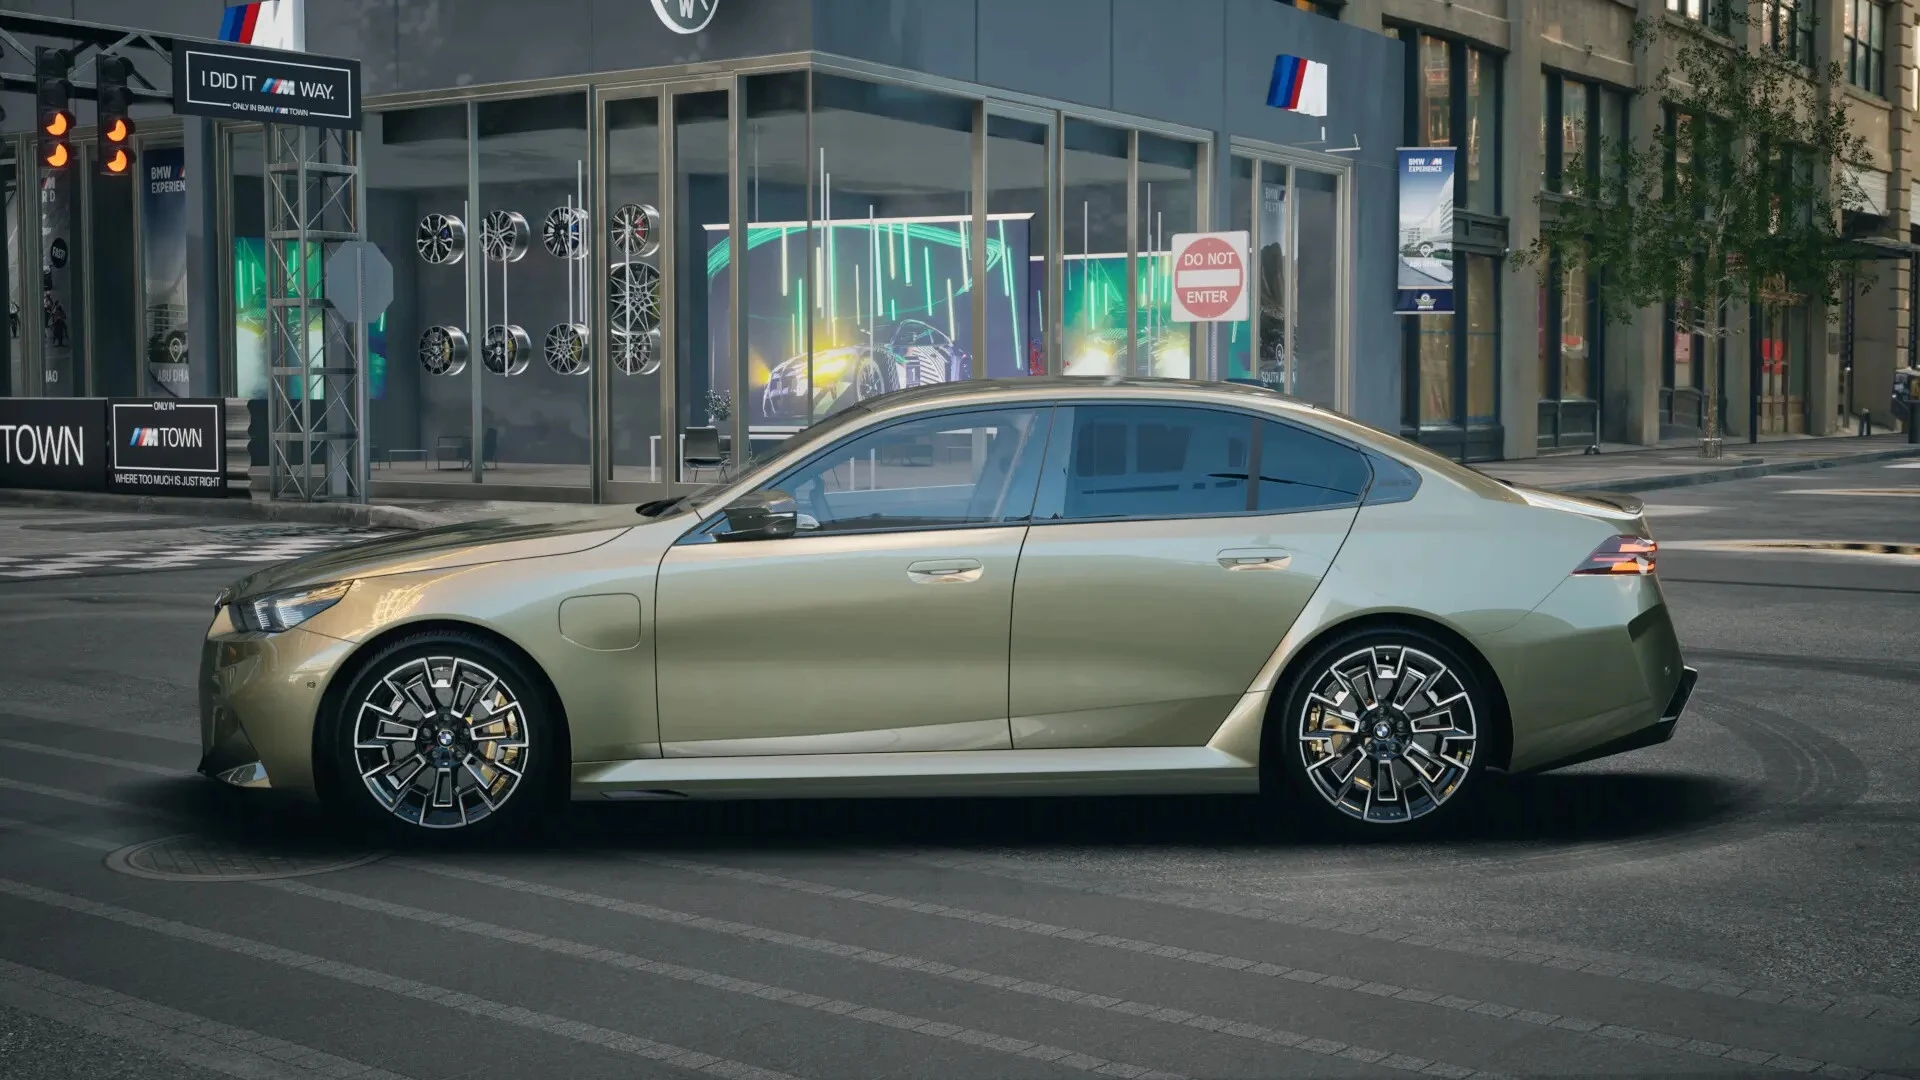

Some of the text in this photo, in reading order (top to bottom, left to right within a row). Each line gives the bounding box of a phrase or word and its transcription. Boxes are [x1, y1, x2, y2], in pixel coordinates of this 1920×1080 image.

[202, 70, 206, 87] I
[210, 71, 238, 90] DID
[242, 75, 257, 92] IT
[300, 81, 335, 100] WAY.
[232, 102, 249, 111] ONLY
[249, 104, 257, 112] IN
[257, 105, 274, 114] BMW
[289, 107, 309, 117] TOWN
[1408, 157, 1426, 166] BMW
[1408, 165, 1443, 173] EXPERIENCE
[151, 166, 171, 180] BMW
[1265, 200, 1286, 215] FESTIV
[1184, 251, 1236, 266] DO NOT
[1187, 290, 1229, 305] ENTER
[157, 368, 171, 383] ABU
[153, 401, 175, 411] ONLY IN
[159, 427, 203, 448] TOWN
[0, 424, 84, 467] TOWN
[115, 473, 220, 488] WHERE TOO MUCH IS JUST RIGHT
